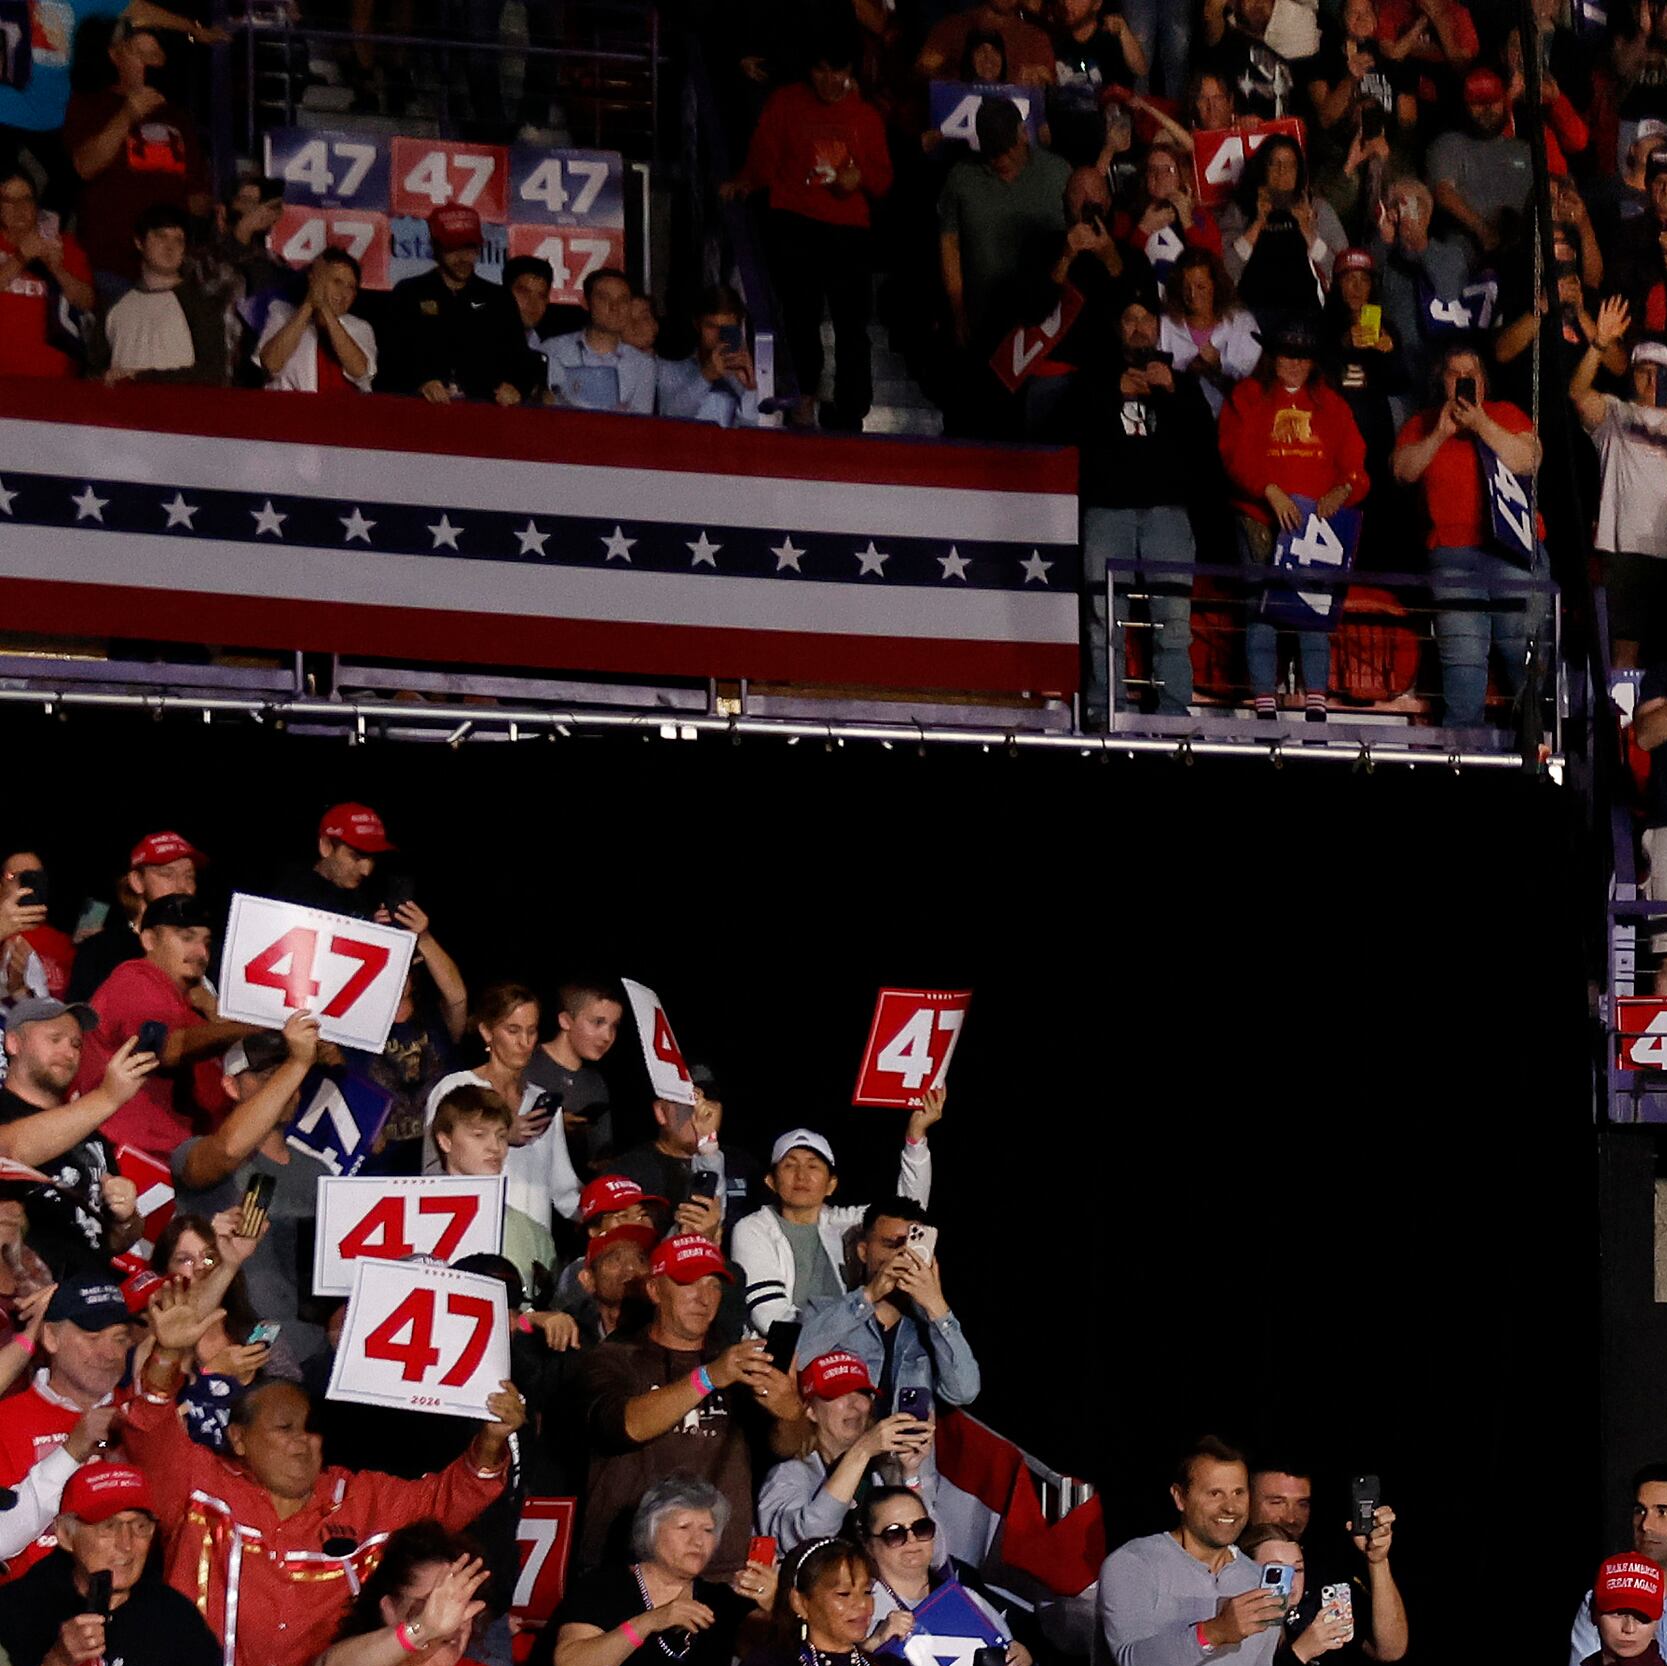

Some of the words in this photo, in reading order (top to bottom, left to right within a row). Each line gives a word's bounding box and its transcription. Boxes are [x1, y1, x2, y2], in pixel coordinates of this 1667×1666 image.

[940, 96, 1030, 152] 4
[284, 140, 376, 197] 47
[403, 151, 495, 207] 47
[519, 158, 608, 213] 47
[1492, 457, 1534, 552] 47
[245, 927, 391, 1018] 47
[877, 1009, 966, 1090] 47
[338, 1195, 480, 1262] 47
[365, 1288, 493, 1387] 47
[511, 1519, 559, 1606] 7
[1606, 1563, 1628, 1575] MAKE
[1628, 1563, 1659, 1580] AMERICA
[1606, 1577, 1633, 1590] GREAT
[1633, 1578, 1658, 1594] AGAIN
